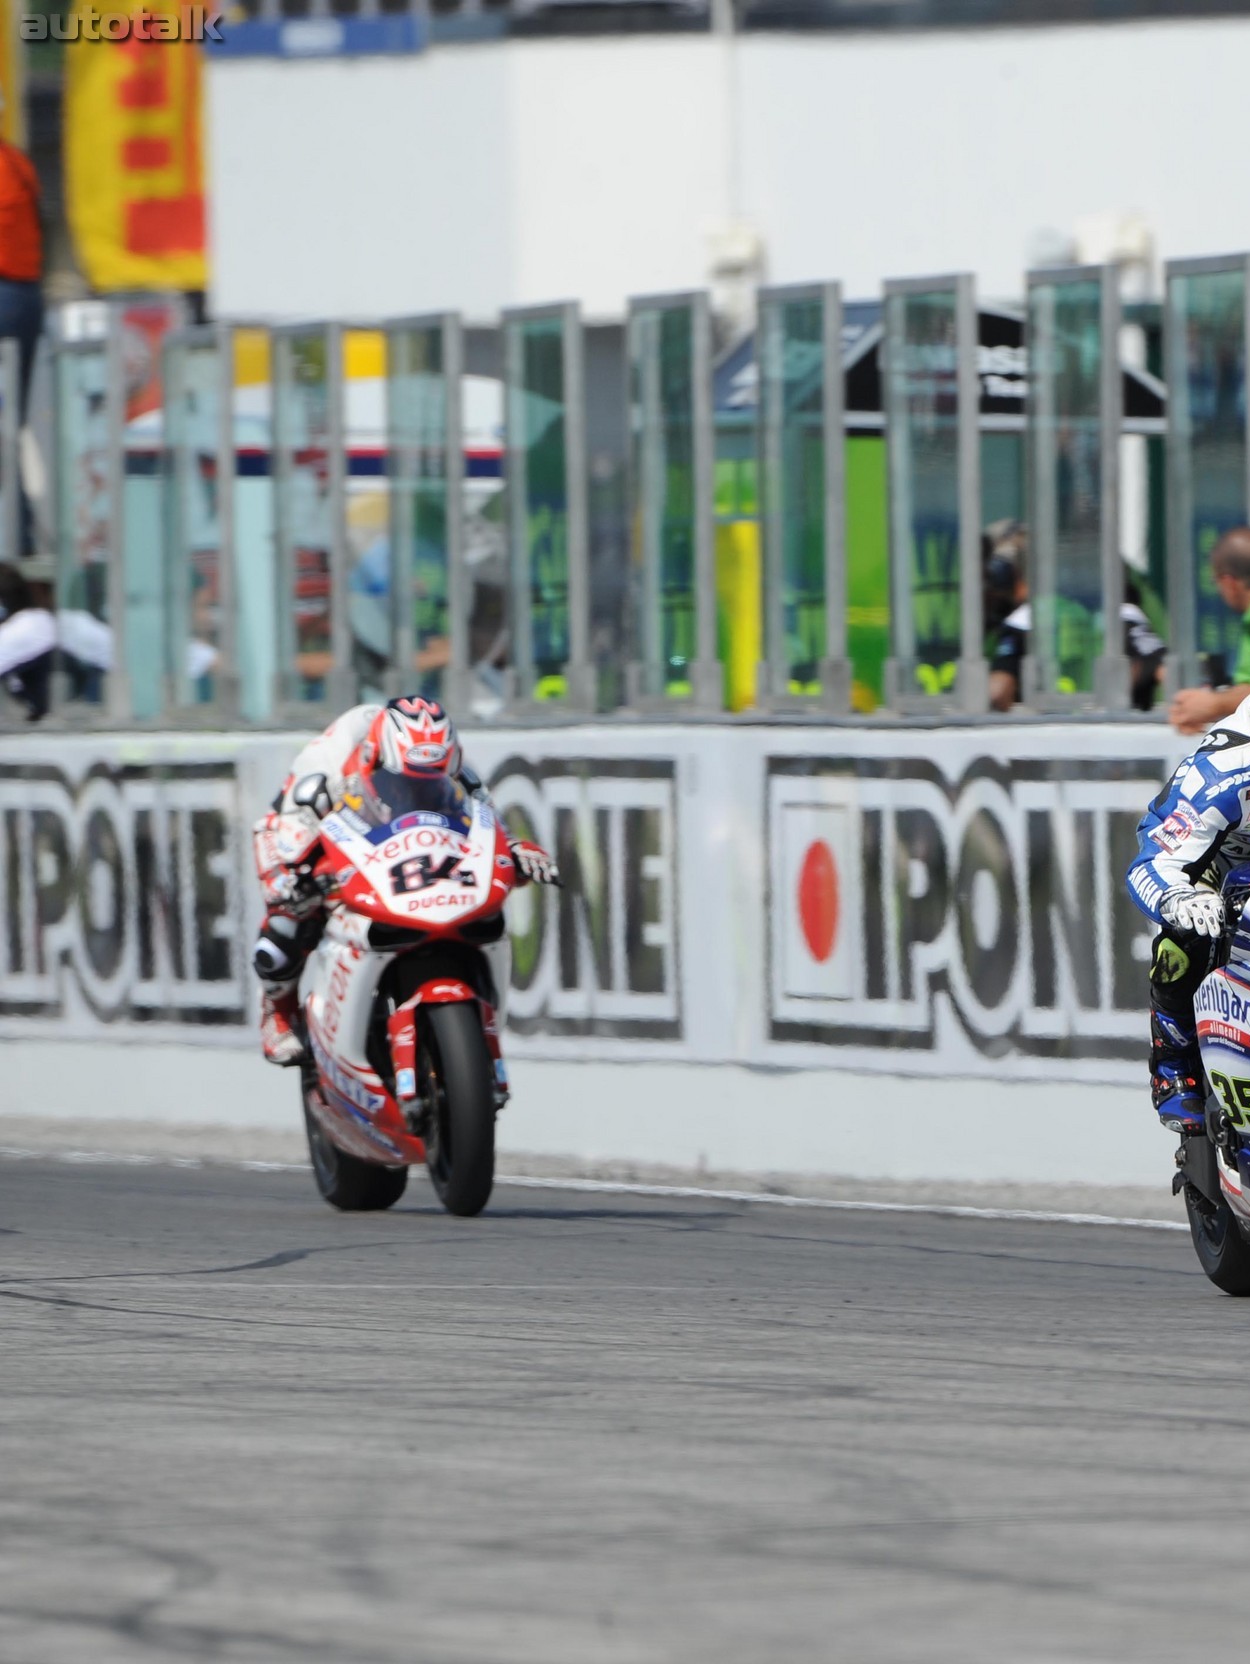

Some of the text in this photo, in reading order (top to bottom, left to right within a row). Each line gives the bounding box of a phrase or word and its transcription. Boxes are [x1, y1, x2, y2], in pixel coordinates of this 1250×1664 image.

[363, 830, 457, 865] xerox
[389, 854, 477, 895] 84
[407, 894, 477, 912] DUCATI
[1209, 1021, 1241, 1041] alimenti
